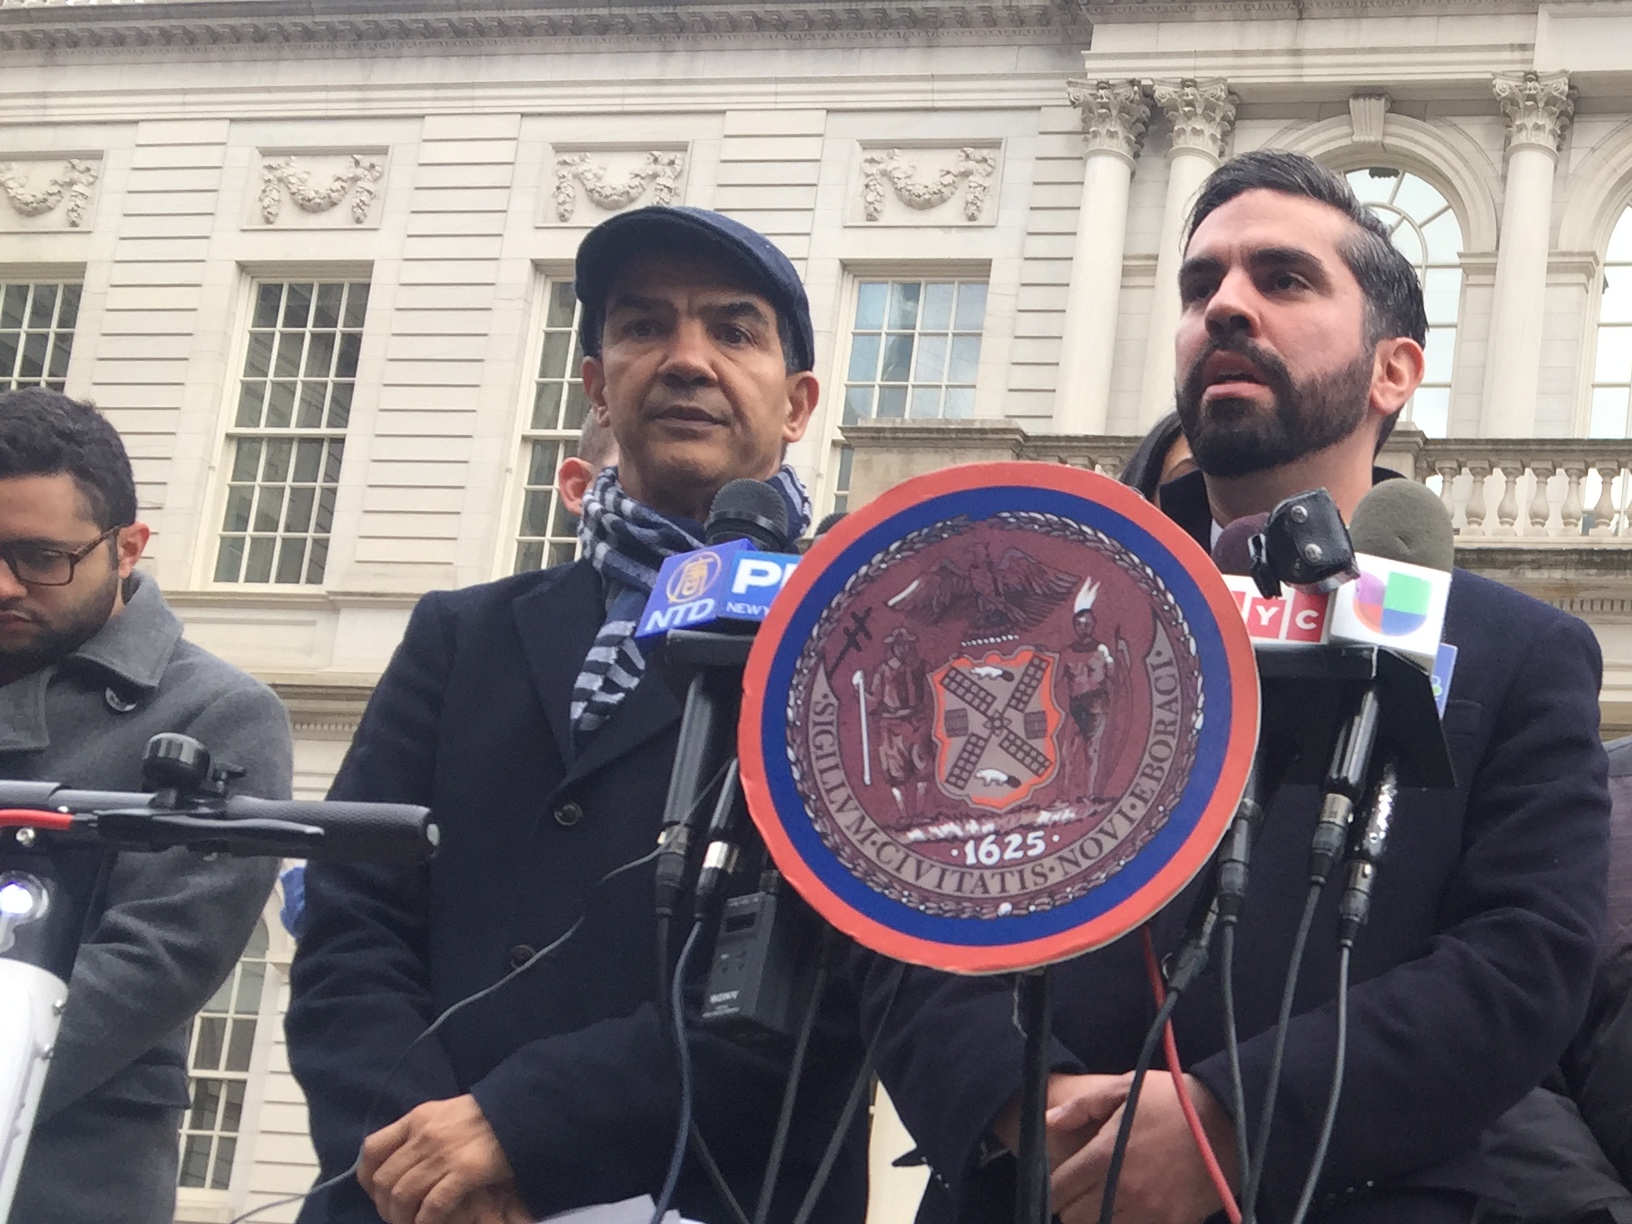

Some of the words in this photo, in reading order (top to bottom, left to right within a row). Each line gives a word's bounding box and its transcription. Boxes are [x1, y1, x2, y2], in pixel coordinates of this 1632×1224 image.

[645, 598, 716, 632] NTD
[1254, 605, 1319, 631] YC
[875, 840, 1049, 896] CIVITATIS
[1056, 805, 1138, 877] NOVI
[1129, 658, 1180, 806] EBORACI
[964, 829, 1047, 867] 1625
